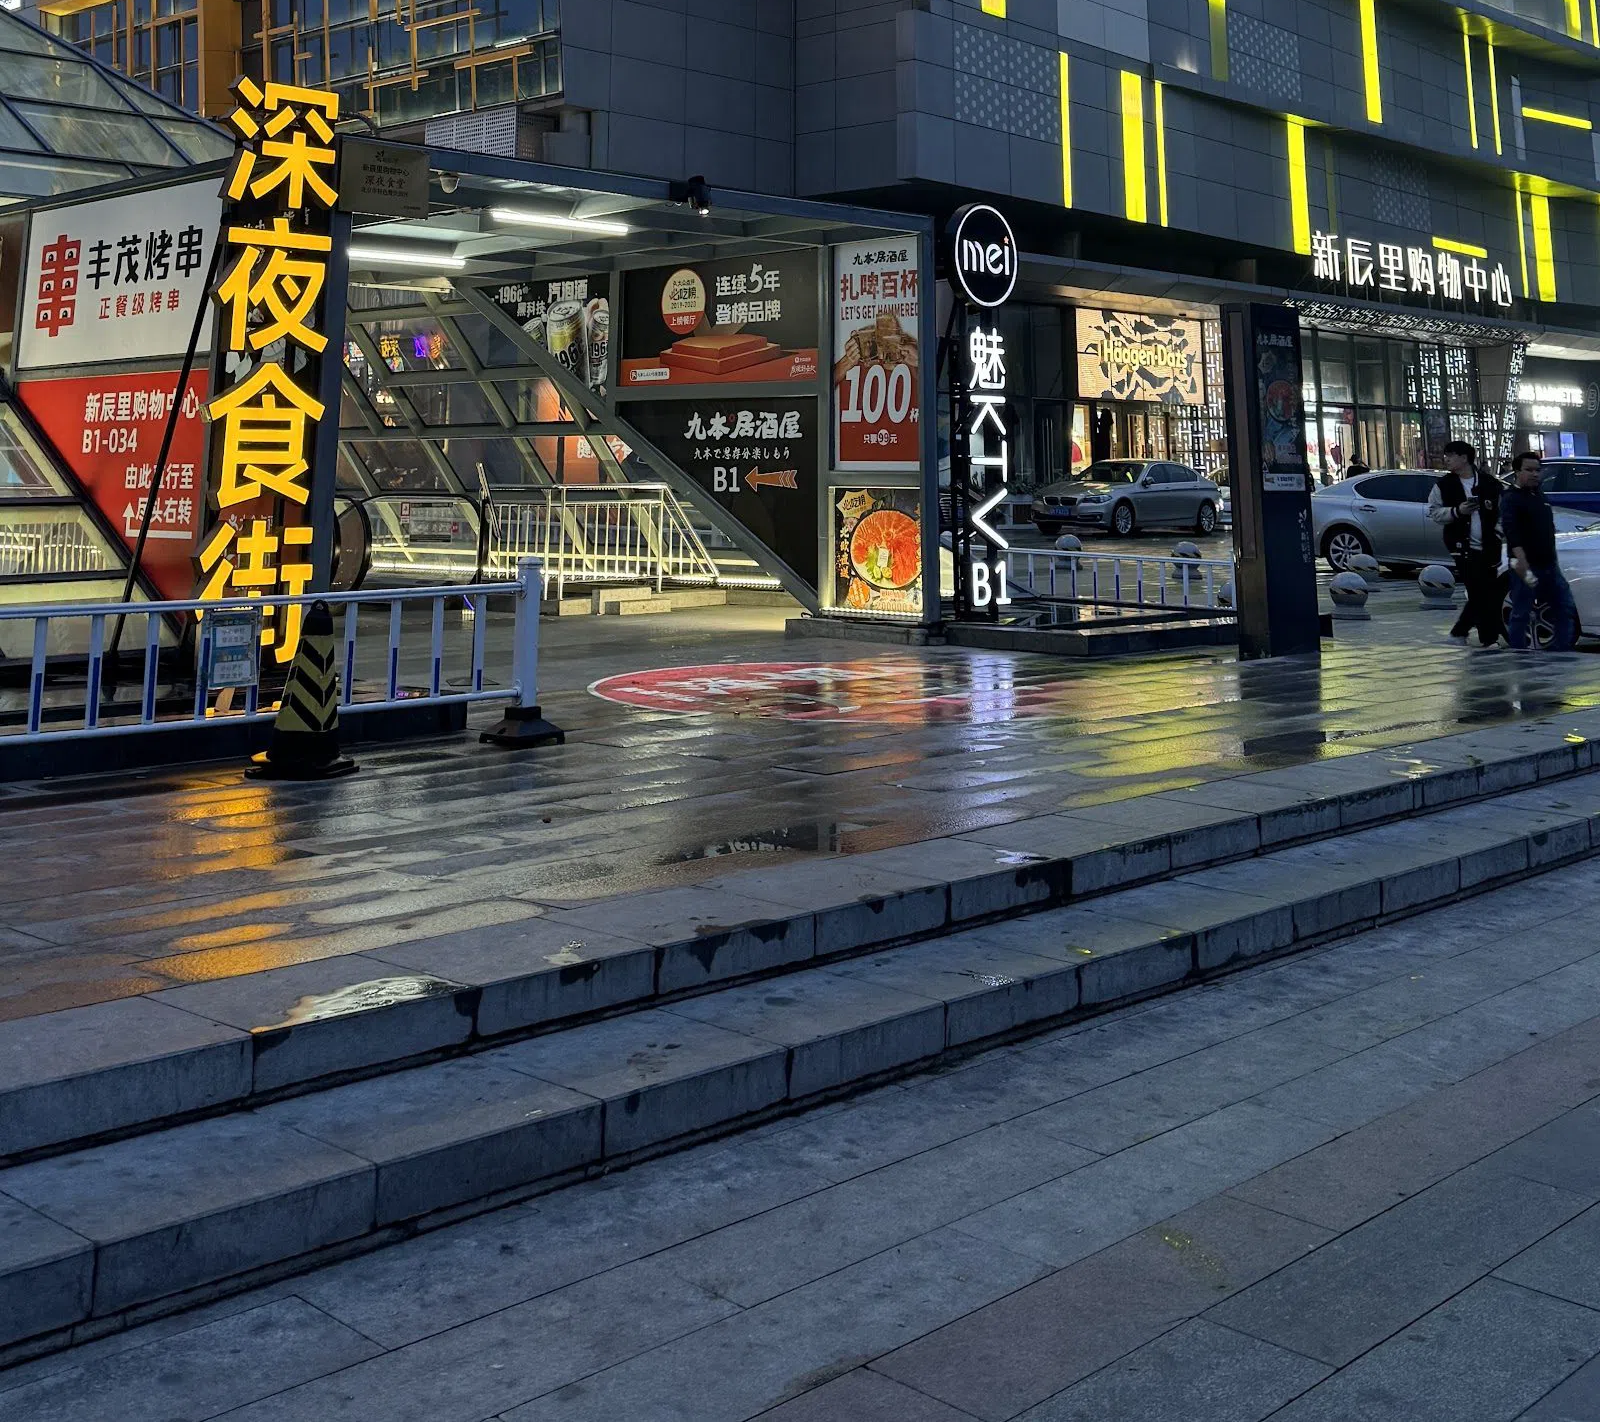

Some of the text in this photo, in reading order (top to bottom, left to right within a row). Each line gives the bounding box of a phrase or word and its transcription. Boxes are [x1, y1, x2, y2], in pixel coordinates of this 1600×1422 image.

[86, 224, 203, 290] 丰茂烤串
[963, 235, 1010, 278] mei
[1311, 230, 1513, 307] 新辰里购物中心
[669, 287, 697, 301] 必吃榜
[715, 263, 781, 297] 连续5年
[840, 268, 918, 302] 扎啤百杯
[98, 287, 180, 320] 正餐级烤串
[516, 300, 546, 318] 黑科技
[715, 299, 781, 325] 登榜品牌
[841, 306, 861, 321] LET'S
[862, 304, 876, 319] GET
[670, 315, 696, 326] 上榜餐厅
[195, 74, 340, 665] 深夜食街
[81, 427, 138, 454] B1-034
[683, 410, 803, 441] 九本居酒屋
[125, 463, 195, 490] 由此行至
[713, 466, 741, 493] B1
[135, 496, 193, 525] 尽头右转
[972, 560, 1012, 608] B1
